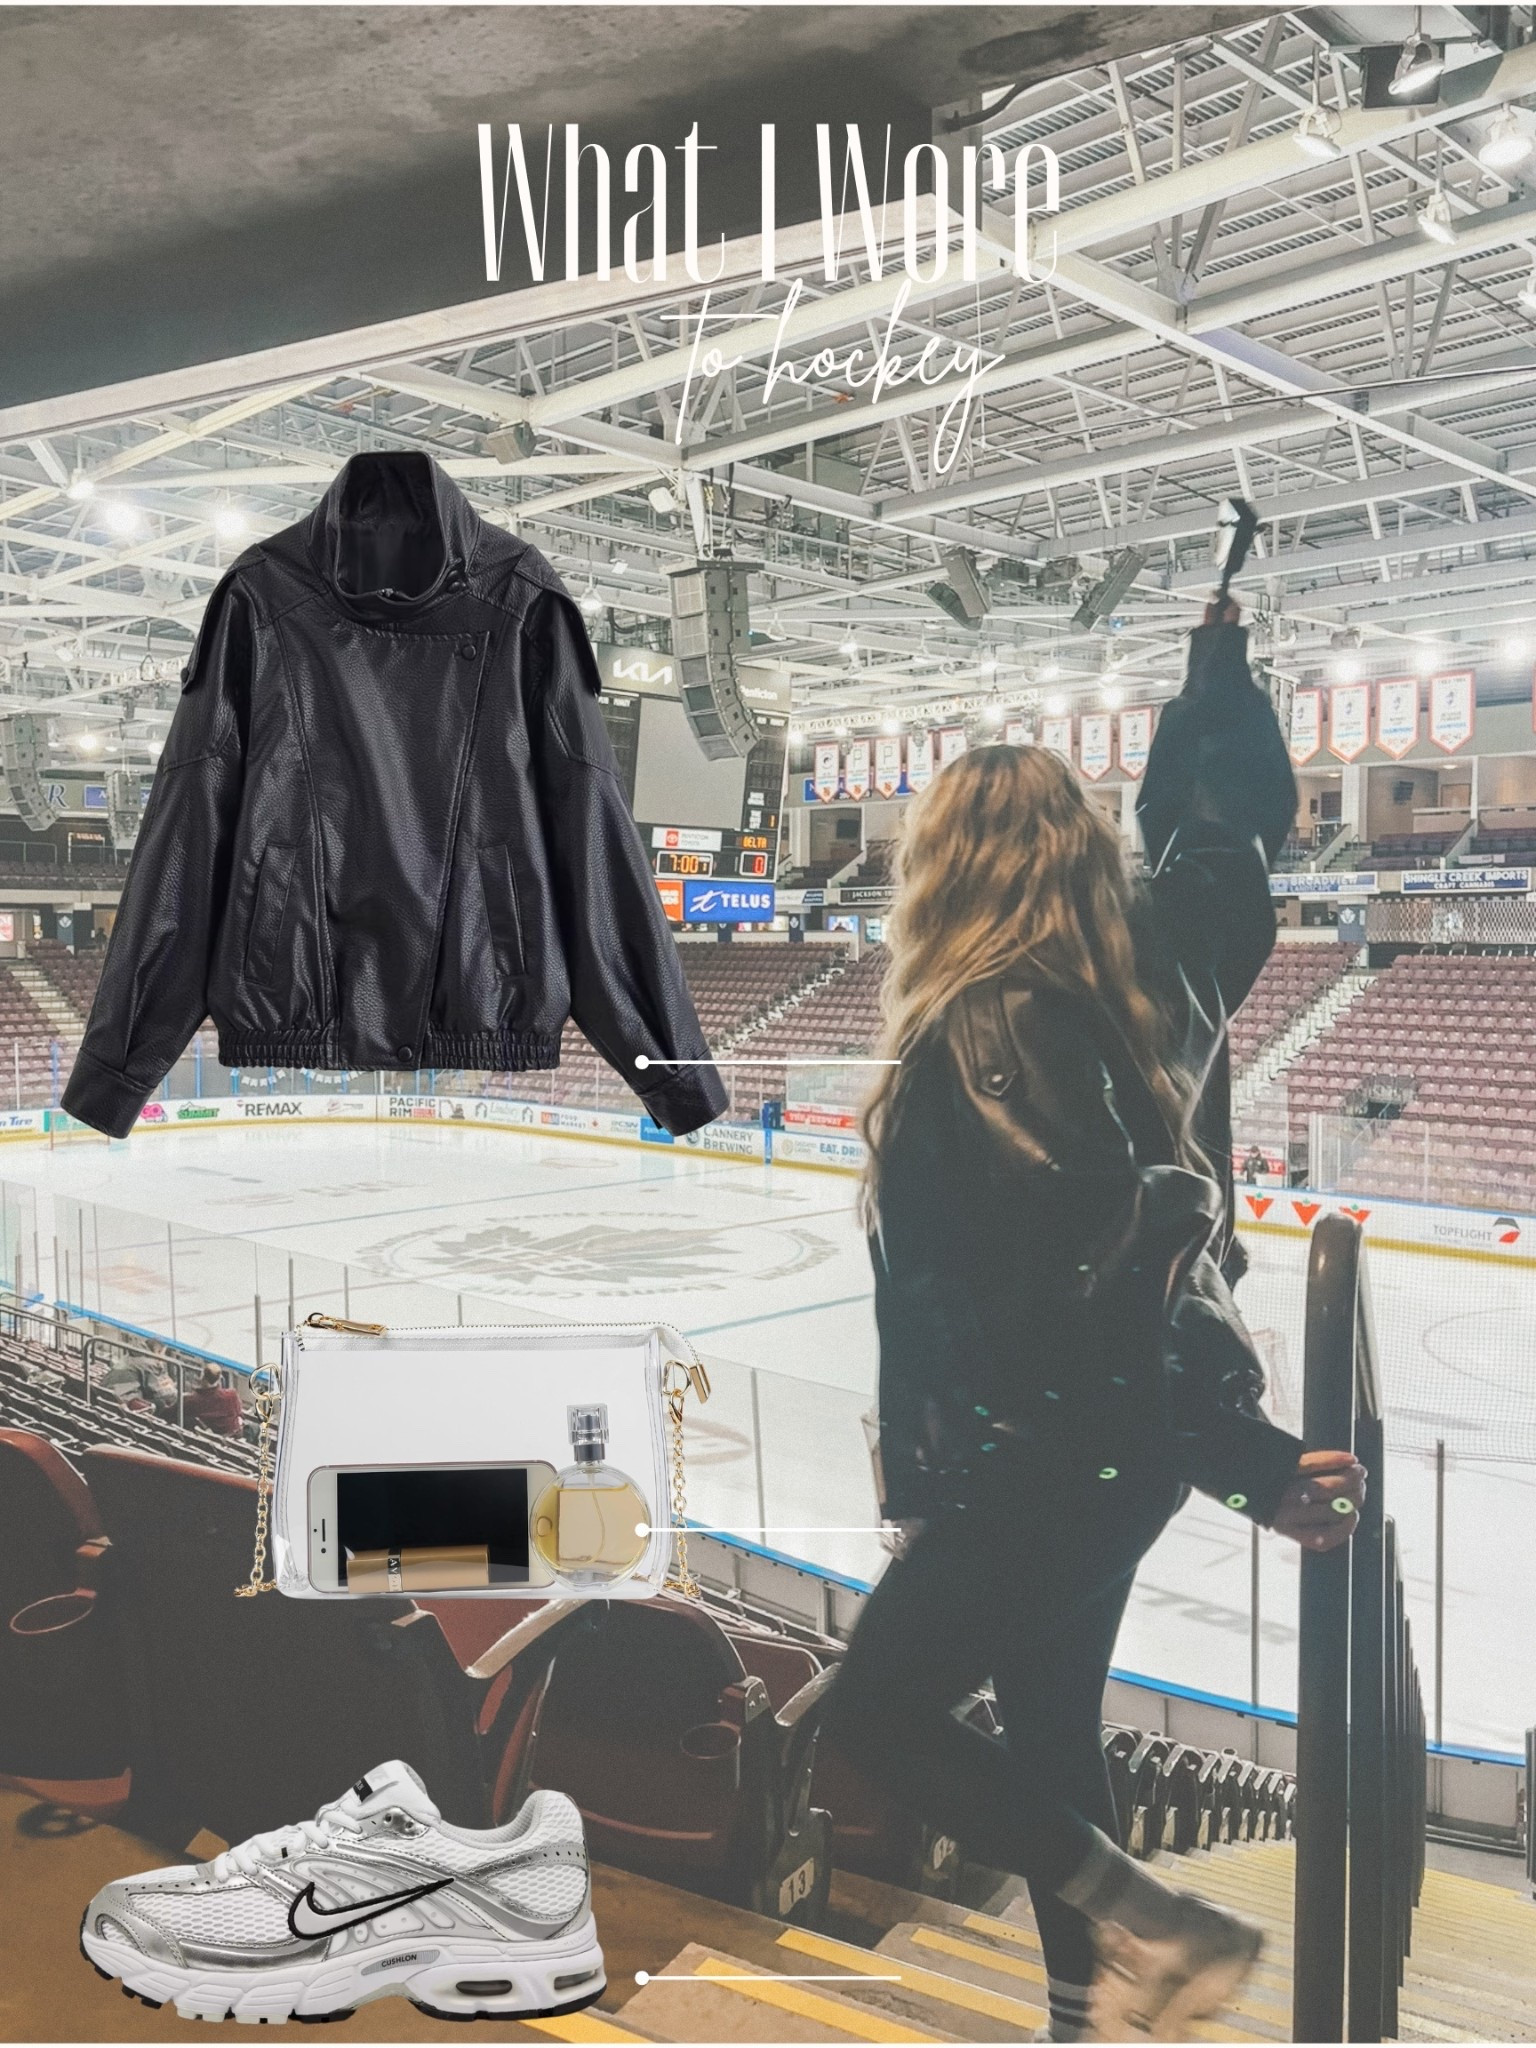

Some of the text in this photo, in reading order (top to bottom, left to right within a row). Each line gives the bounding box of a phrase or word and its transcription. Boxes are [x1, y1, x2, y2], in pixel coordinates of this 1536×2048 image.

[613, 658, 673, 685] KIA
[670, 854, 699, 874] 7:00
[1404, 870, 1528, 883] SHINGLE CREEK IMPORTS
[721, 893, 771, 908] TELUS
[245, 1102, 303, 1117] REMAX
[389, 1097, 436, 1107] PACIFIC
[389, 1107, 412, 1118] RIM
[703, 1138, 753, 1155] BREWING
[1433, 1224, 1493, 1241] TOPFLIGHT
[788, 1869, 806, 1903] 13
[381, 1954, 417, 1967] CUSHLON
